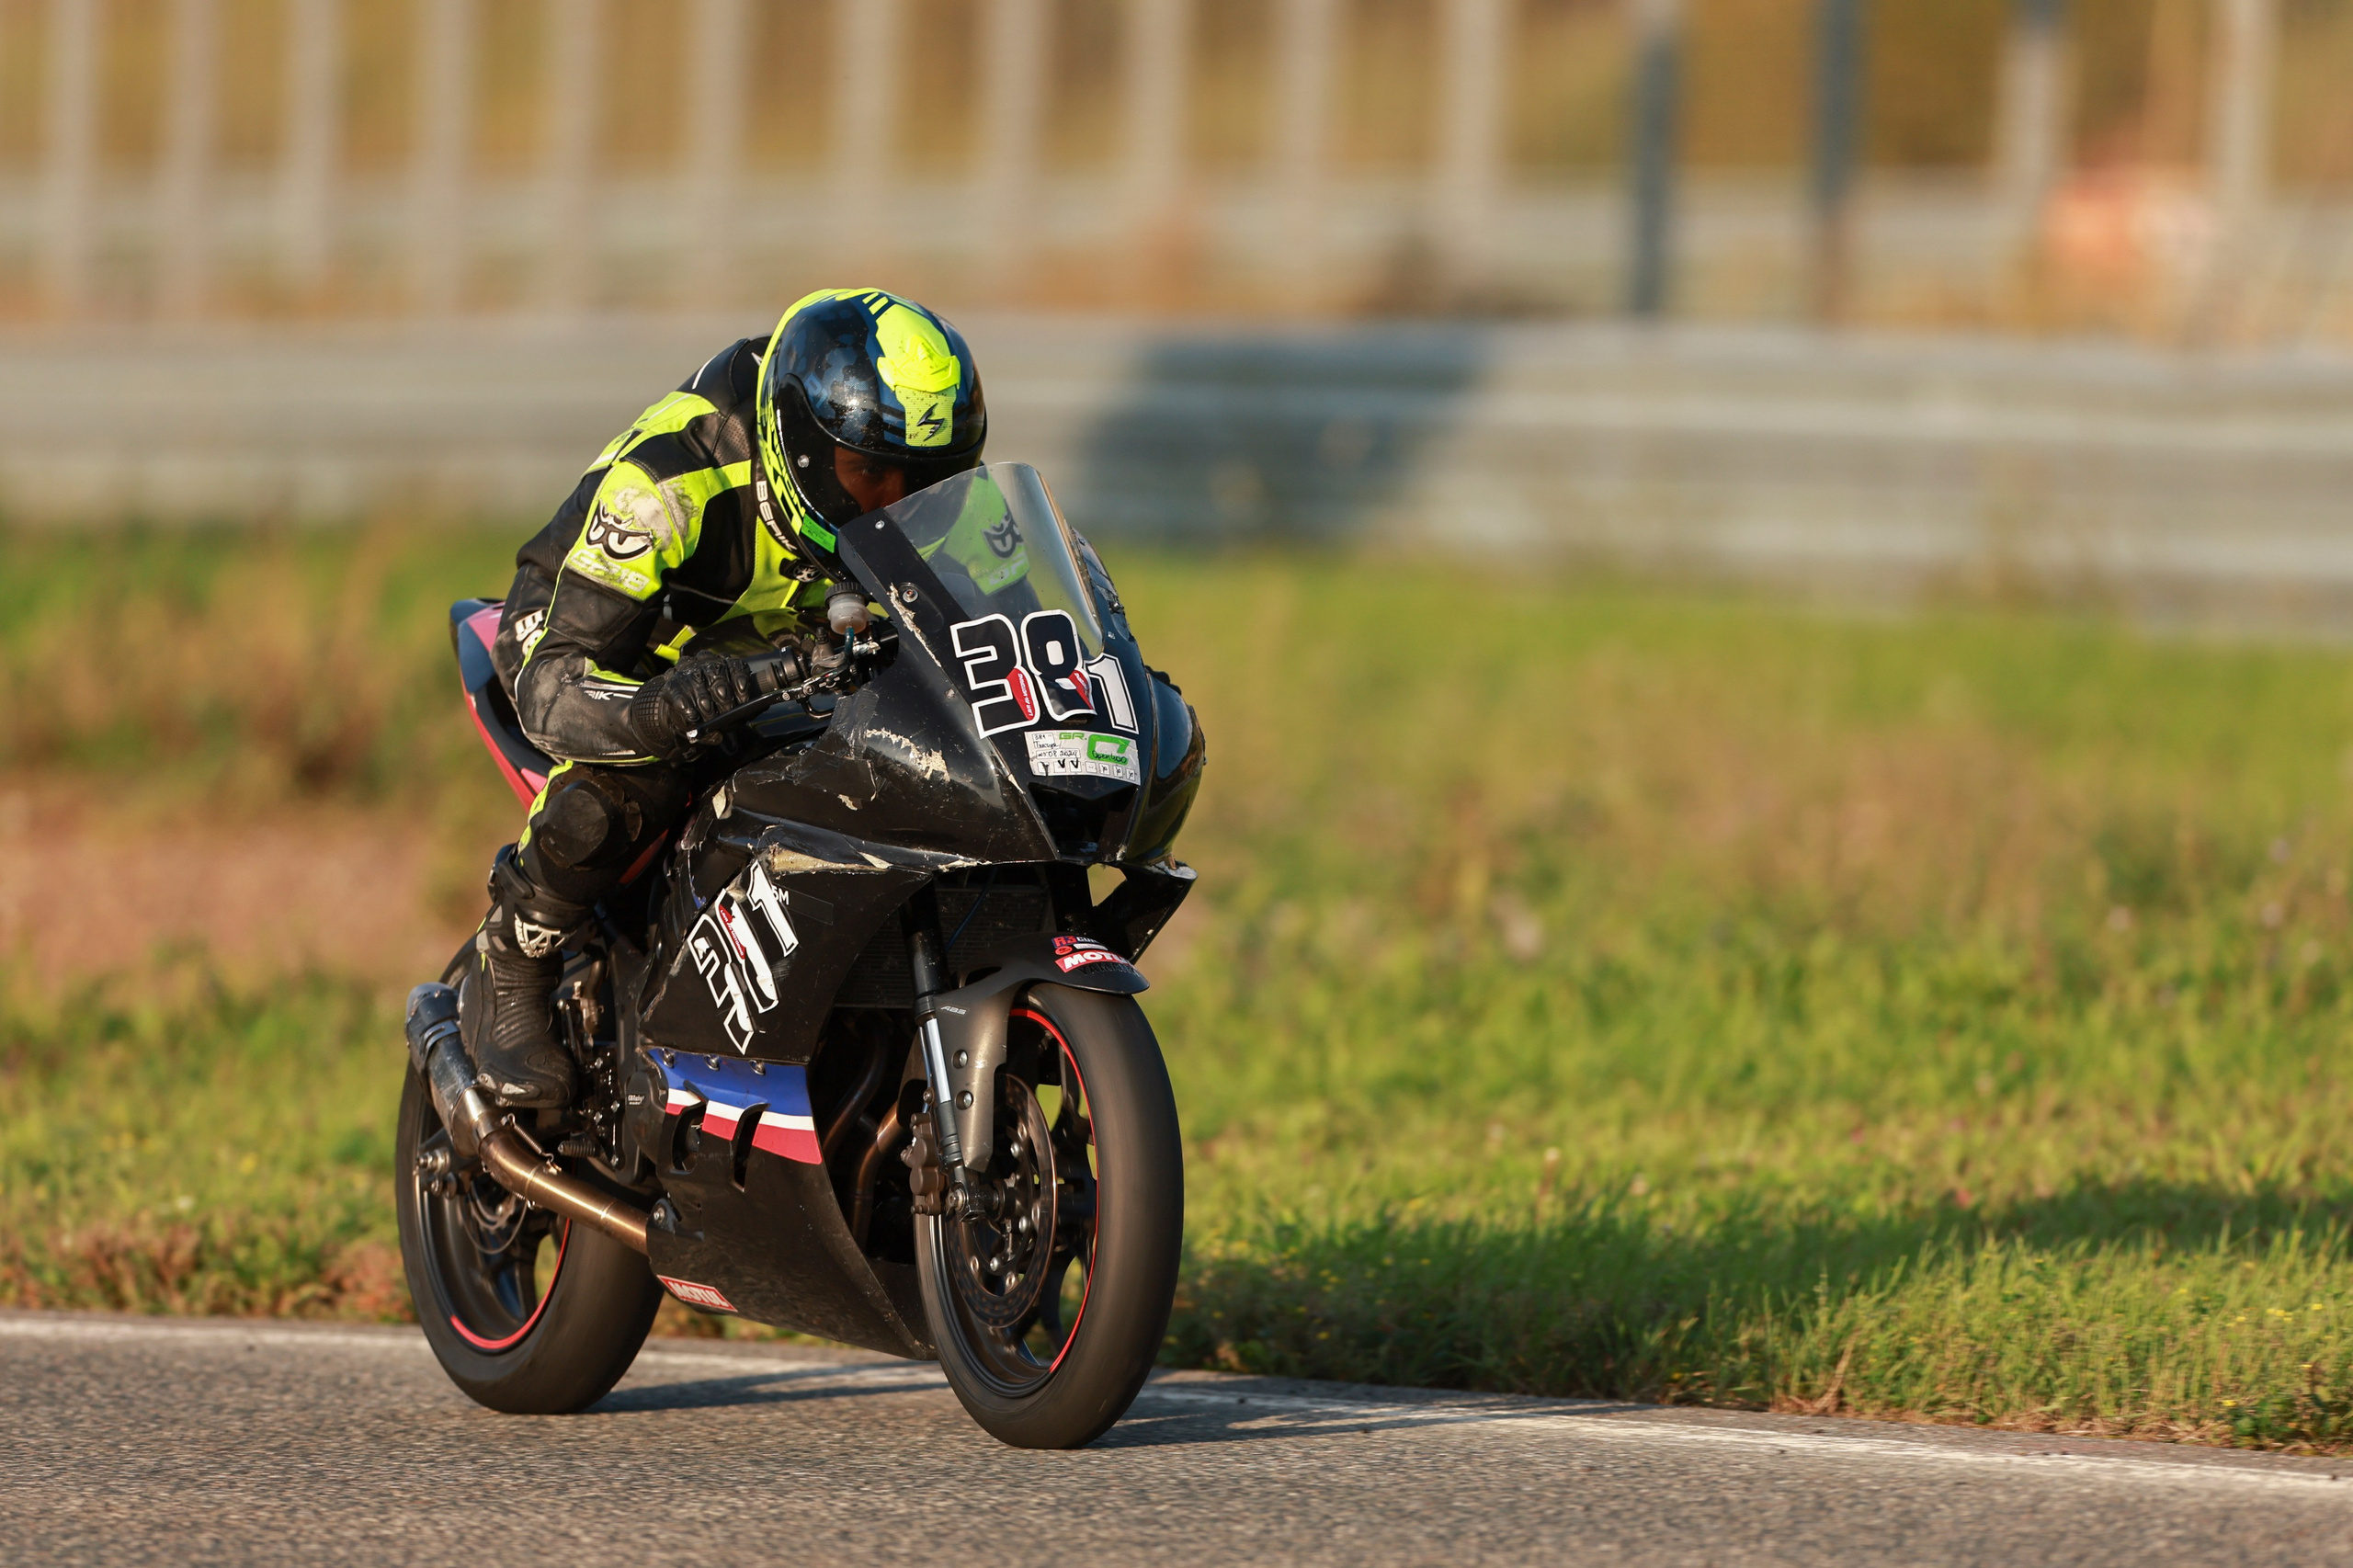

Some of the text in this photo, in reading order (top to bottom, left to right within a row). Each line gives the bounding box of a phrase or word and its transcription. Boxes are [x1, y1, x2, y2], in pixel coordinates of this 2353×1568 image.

[756, 480, 798, 551] BERIK
[949, 608, 1139, 739] 381
[1064, 951, 1130, 970] MOTU
[940, 1006, 967, 1016] ABS
[668, 1280, 730, 1308] MOTUL
